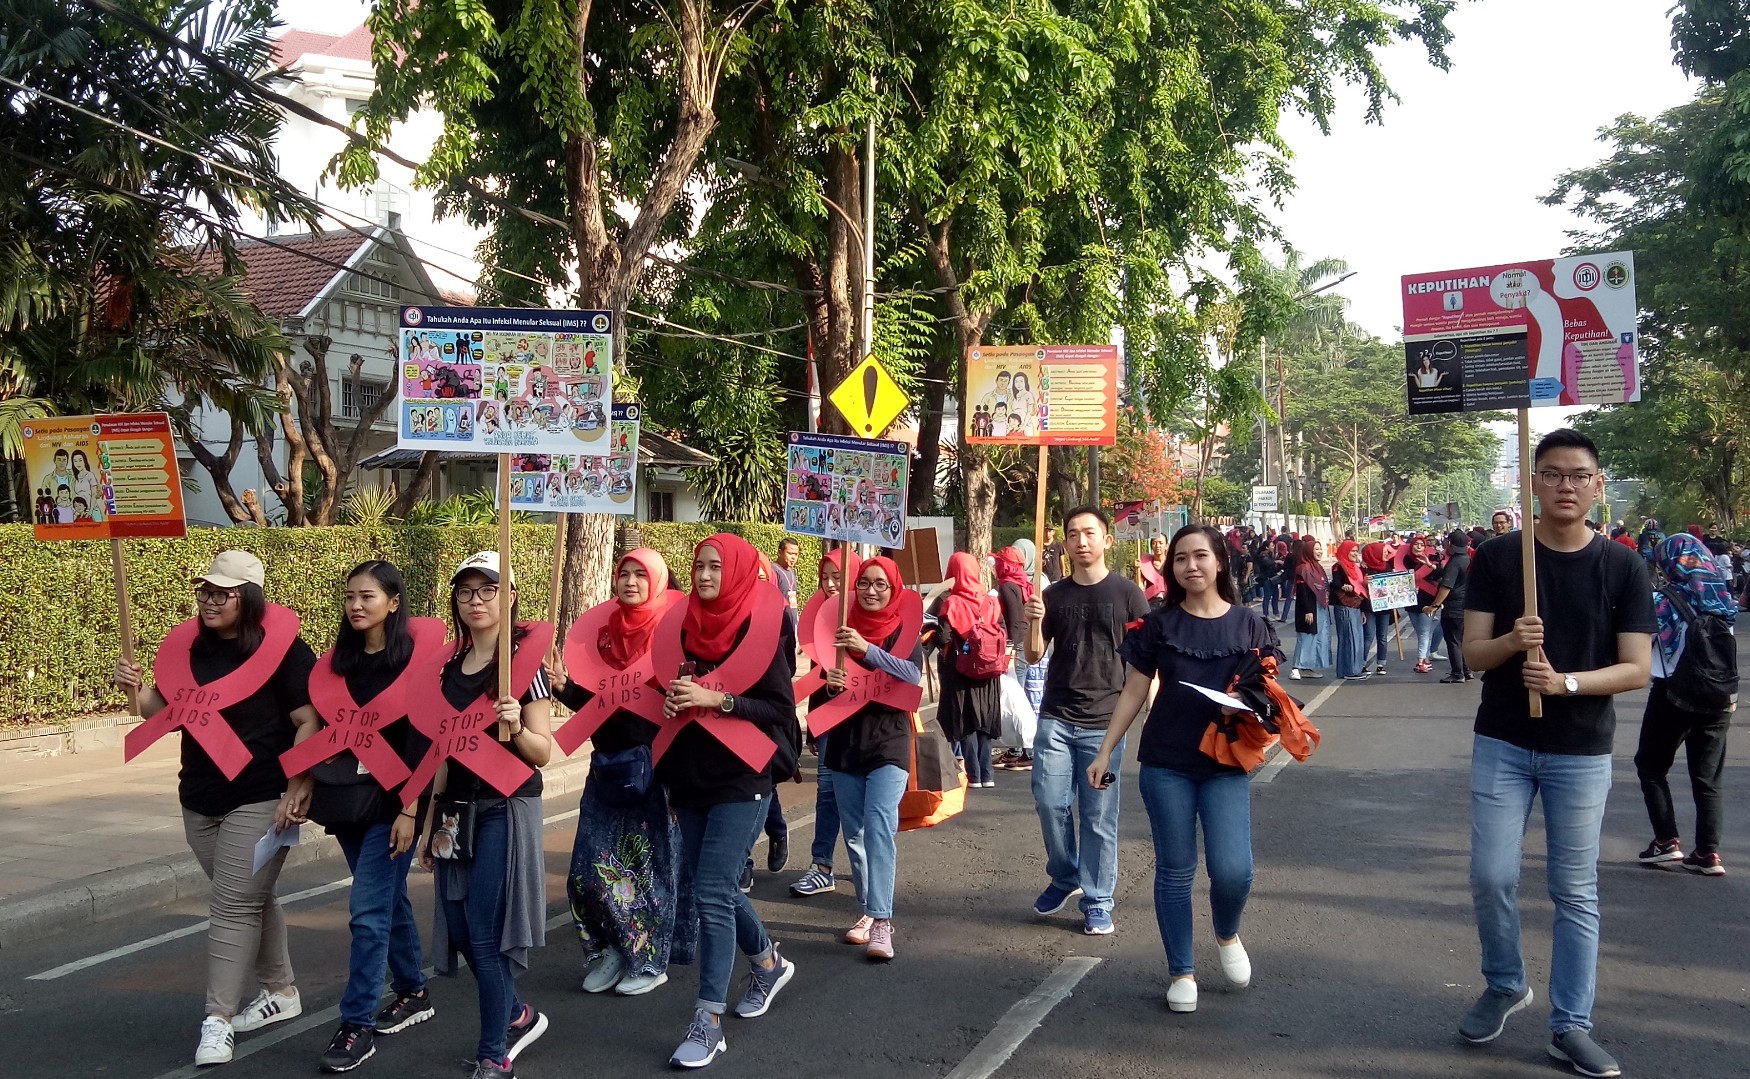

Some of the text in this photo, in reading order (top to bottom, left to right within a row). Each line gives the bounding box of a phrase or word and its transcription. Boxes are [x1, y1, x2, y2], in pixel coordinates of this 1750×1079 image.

[1503, 271, 1526, 279] Normal
[1408, 276, 1490, 294] KEPUTIHAN
[1500, 290, 1530, 298] Penyakit?
[427, 315, 452, 323] Tahukah
[470, 317, 481, 325] Apa
[513, 318, 538, 326] Menular
[539, 319, 562, 327] Seksual
[563, 319, 579, 328] (IMS)
[1564, 319, 1587, 327] Bebas
[1565, 329, 1608, 341] Keputihan!
[108, 500, 117, 515] E
[599, 672, 642, 691] STOP
[174, 688, 220, 706] STOP
[598, 687, 641, 709] AIDS
[849, 682, 891, 702] AIDS
[166, 707, 211, 727] AIDS
[335, 708, 380, 727] STOP
[439, 713, 484, 735] STOP
[328, 728, 374, 749] AIDS
[434, 736, 479, 758] AIDS
